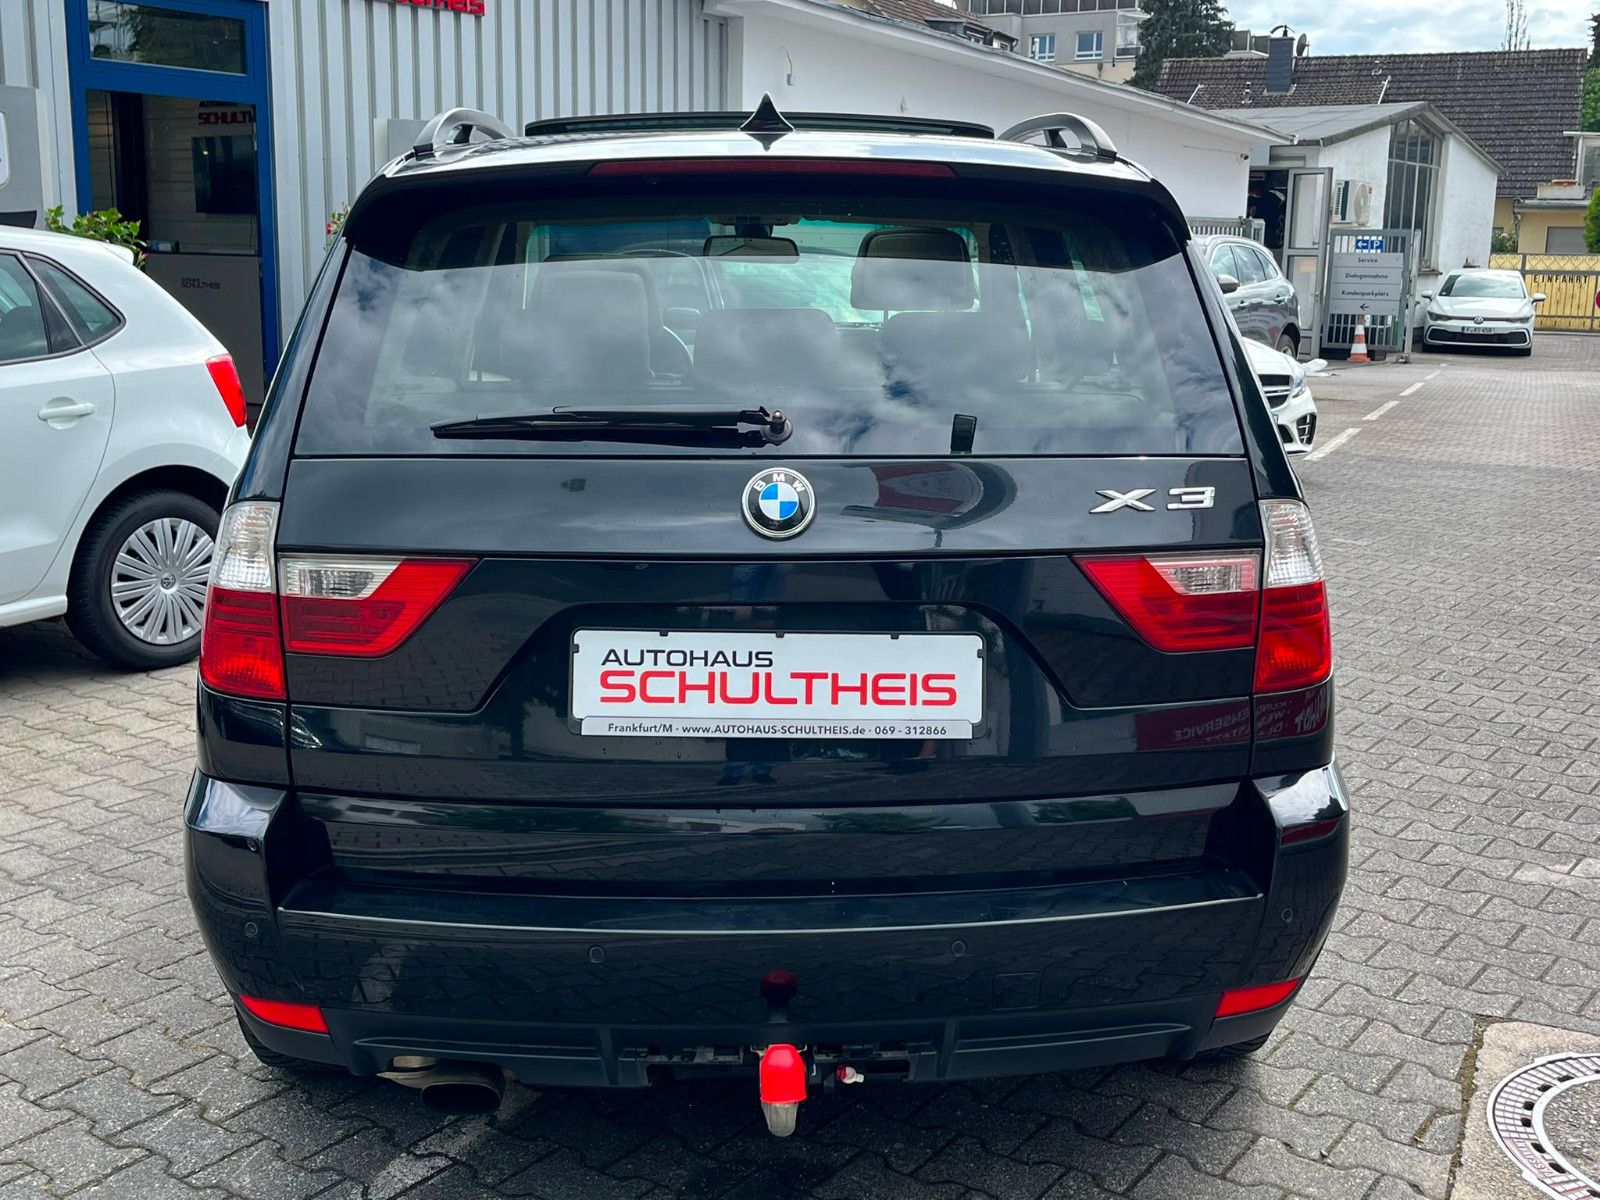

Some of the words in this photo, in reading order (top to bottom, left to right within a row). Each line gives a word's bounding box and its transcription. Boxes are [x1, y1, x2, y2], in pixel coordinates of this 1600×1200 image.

[1373, 240, 1380, 248] P
[1533, 275, 1588, 284] EINFAHRT
[753, 473, 806, 492] BMW
[600, 648, 774, 668] AUTOHAUS
[599, 670, 957, 707] SCHULTHEIS
[608, 723, 673, 733] Frankfurt/M
[682, 723, 865, 736] www.AUTOHAUS-SCHULTHEIS.de
[874, 725, 896, 735] 069
[905, 726, 947, 736] 312866
